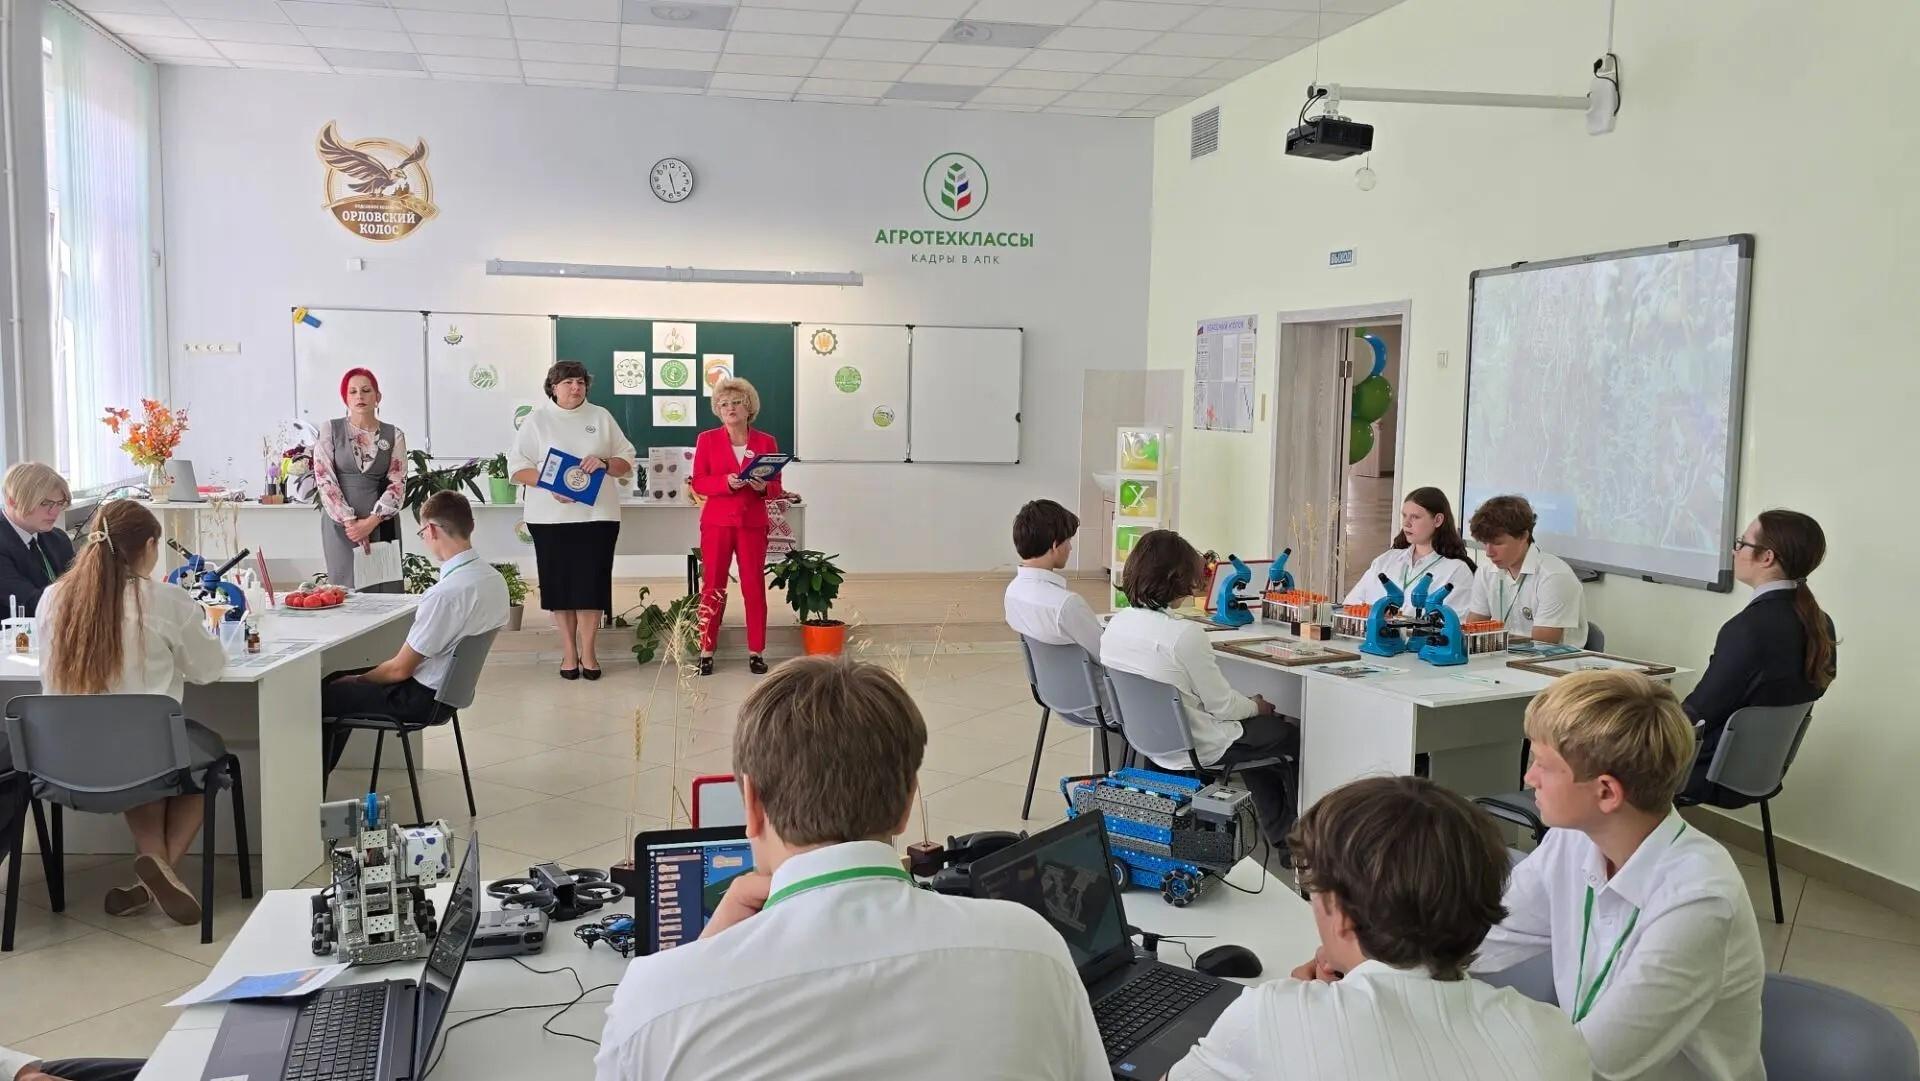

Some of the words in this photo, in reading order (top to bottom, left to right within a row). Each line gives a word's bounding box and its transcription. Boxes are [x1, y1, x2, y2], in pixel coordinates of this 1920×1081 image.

[342, 210, 416, 223] ОРЛОВСКИЙ
[359, 224, 399, 234] КОЛОС
[875, 229, 1034, 248] АГРОТЕХКЛАССЫ
[911, 254, 955, 264] КАДРЫ
[962, 255, 968, 263] В
[974, 255, 1000, 264] АПК
